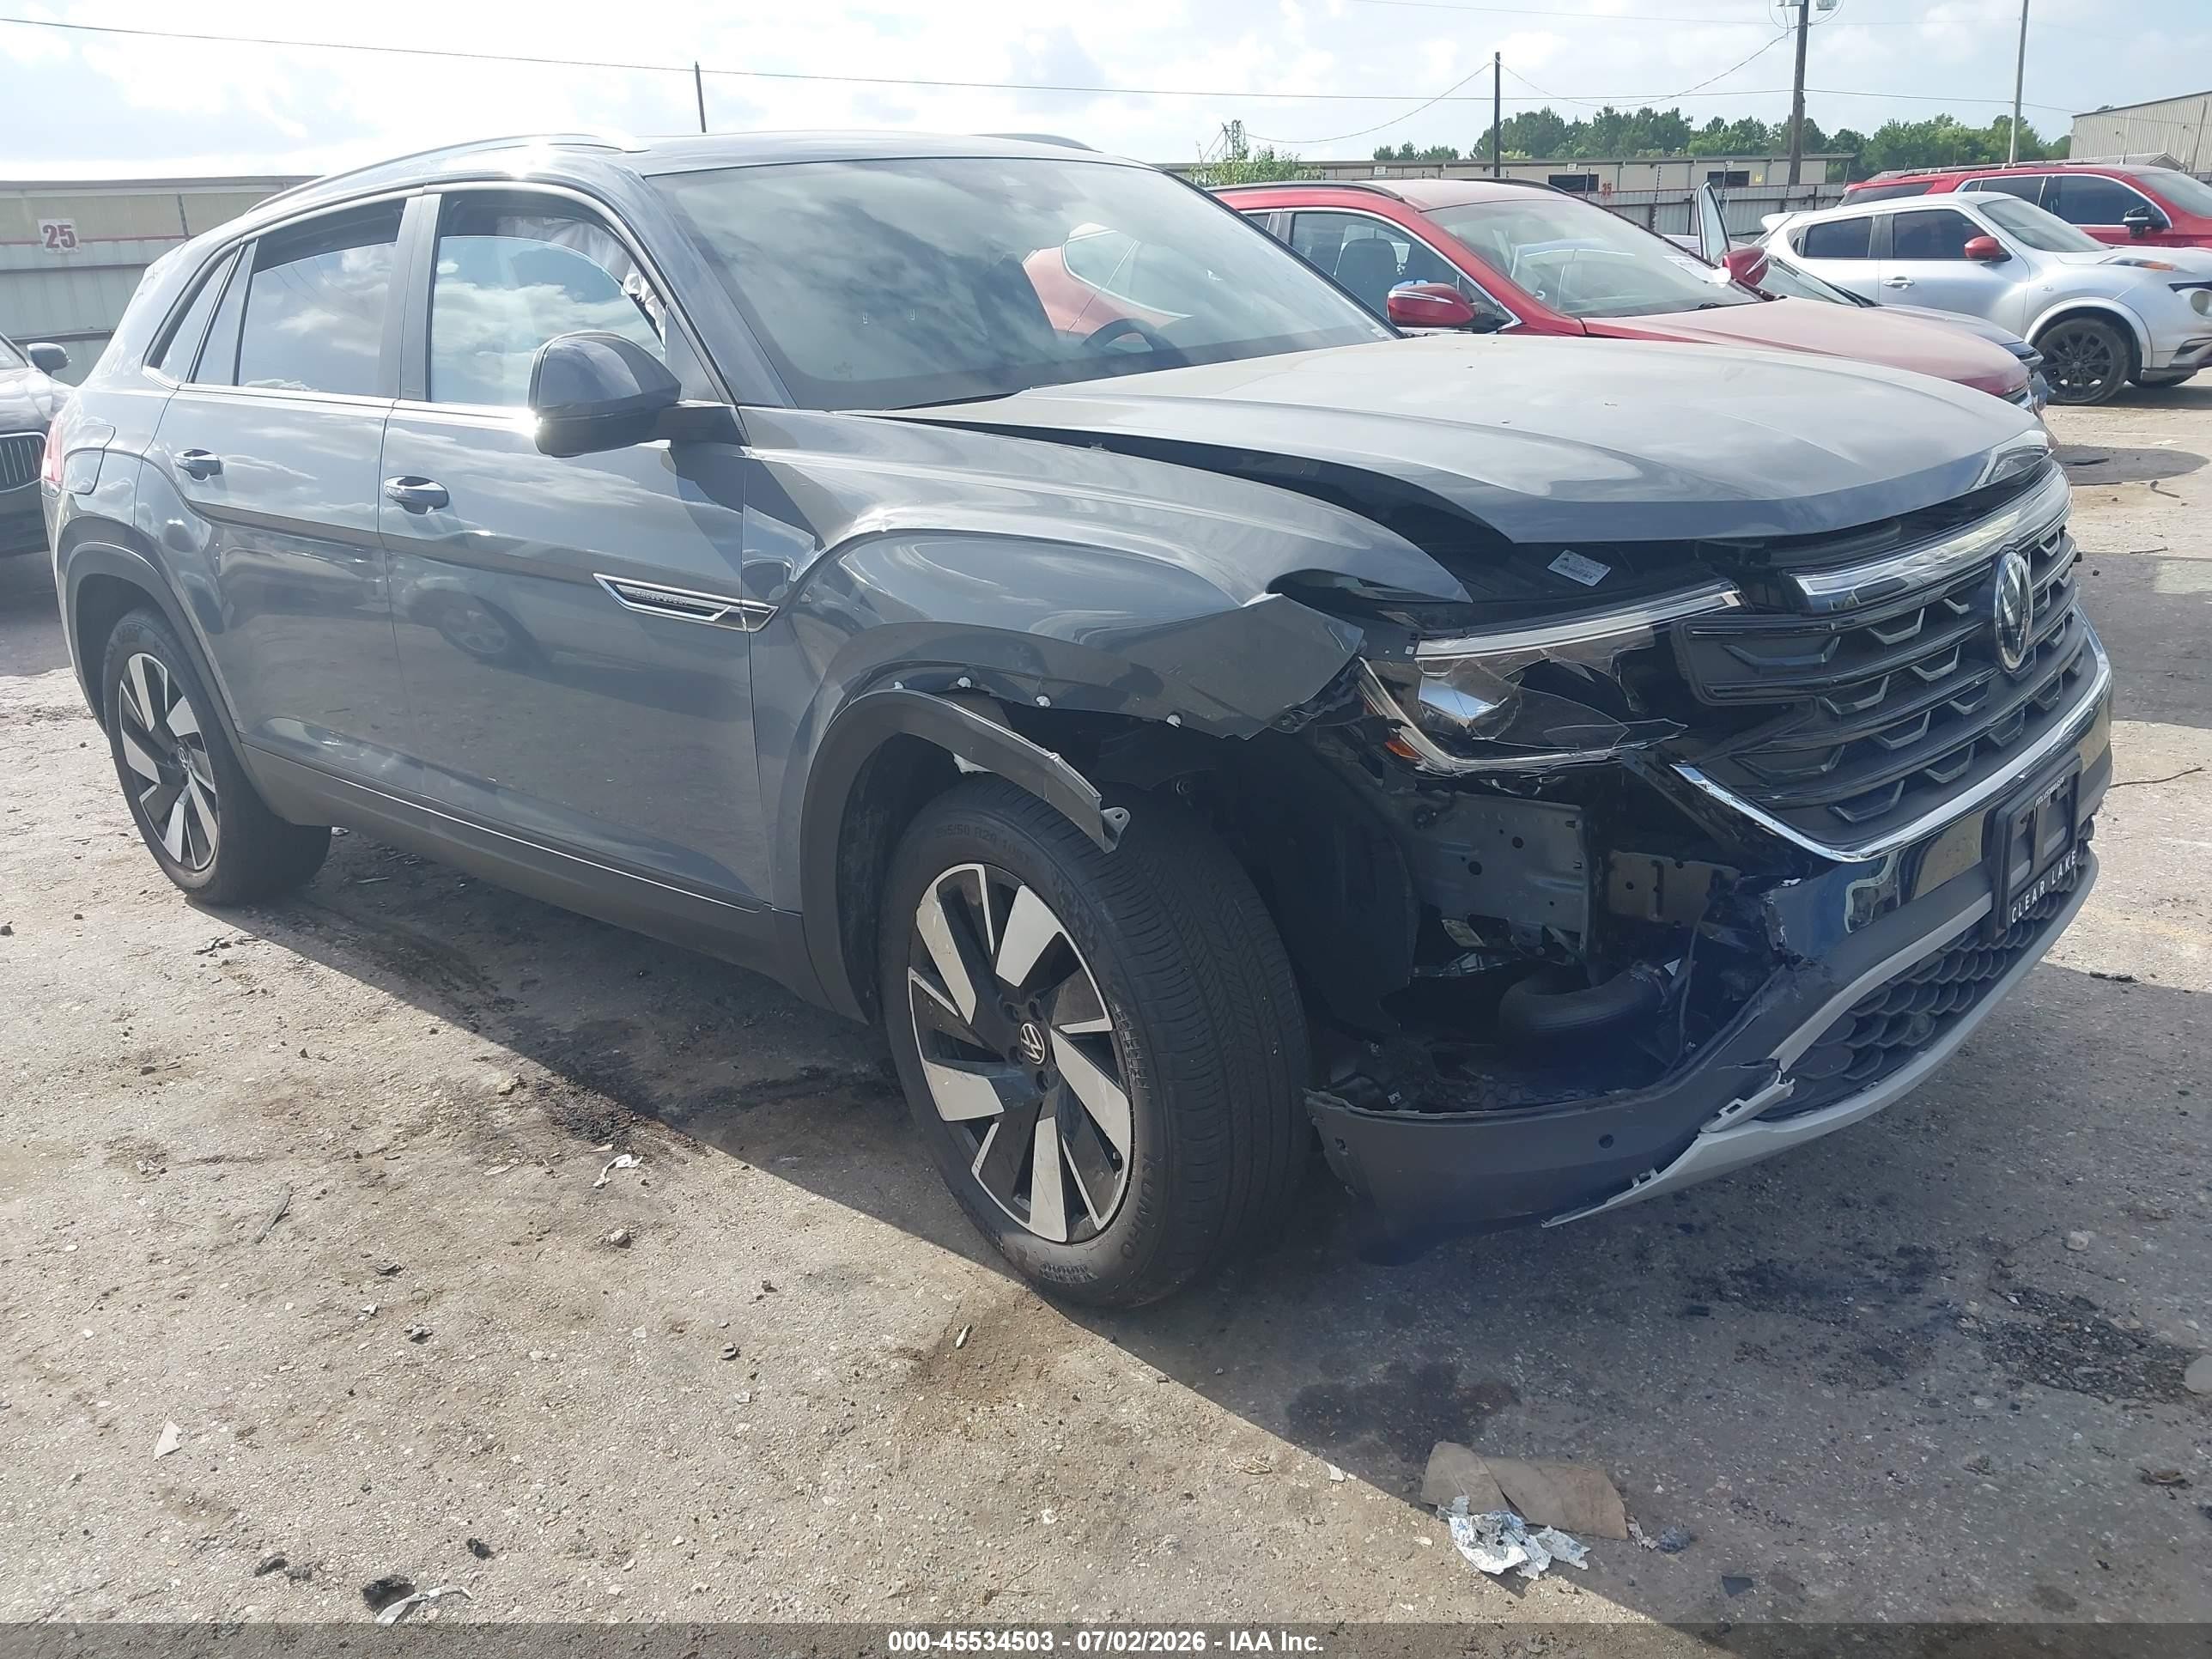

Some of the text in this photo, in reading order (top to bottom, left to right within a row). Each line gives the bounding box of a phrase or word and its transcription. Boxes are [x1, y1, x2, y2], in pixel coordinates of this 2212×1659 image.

[1601, 182, 1613, 196] 35
[42, 224, 76, 248] 25
[2011, 850, 2076, 924] CLEAR LAKE
